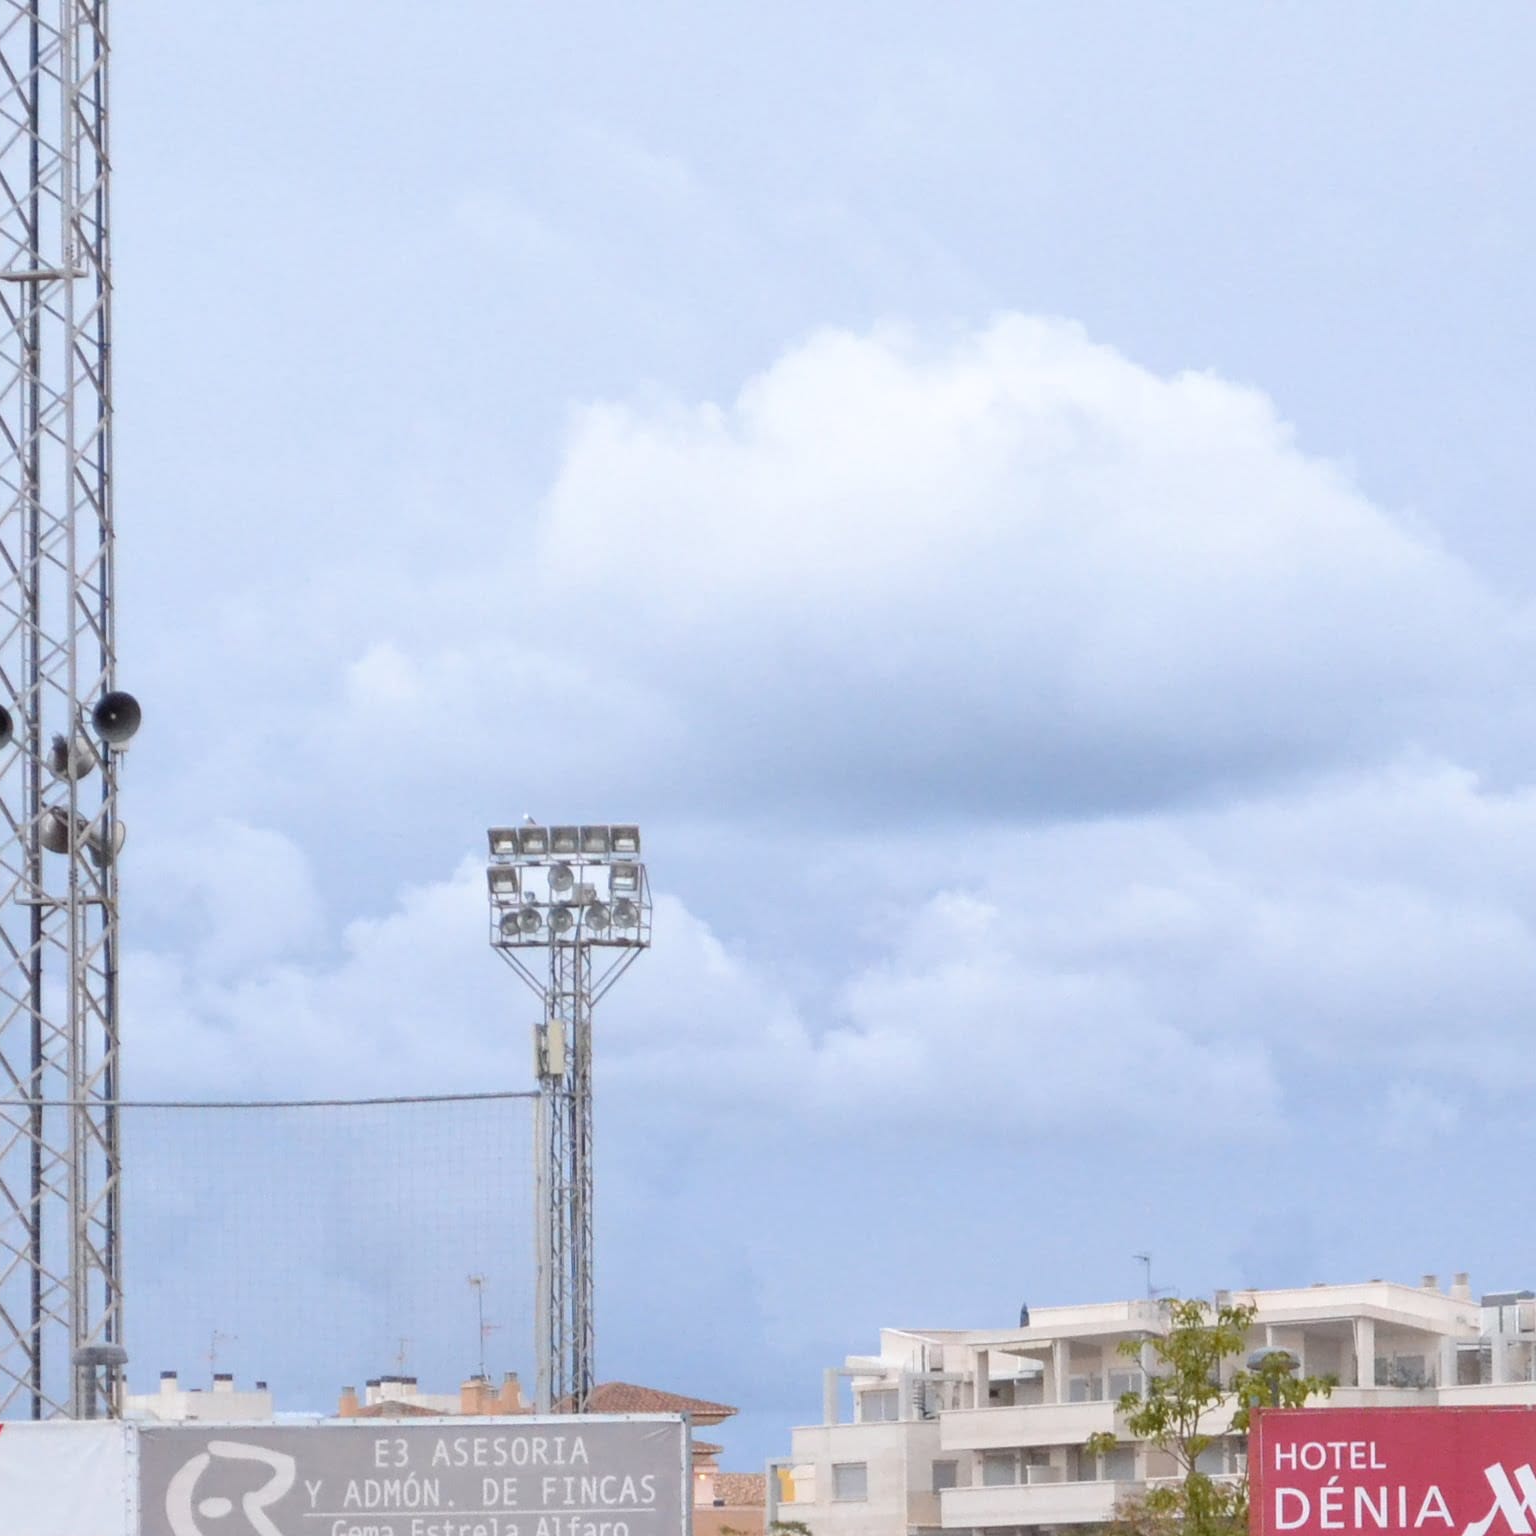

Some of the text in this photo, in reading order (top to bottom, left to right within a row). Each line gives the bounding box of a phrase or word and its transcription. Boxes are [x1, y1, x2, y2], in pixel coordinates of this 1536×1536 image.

[375, 1436, 589, 1467] E3 ASESORIA
[1274, 1441, 1386, 1471] HOTEL
[304, 1471, 656, 1508] Y ADMÓN. DE FINCAS
[1275, 1476, 1454, 1530] DÉNIA
